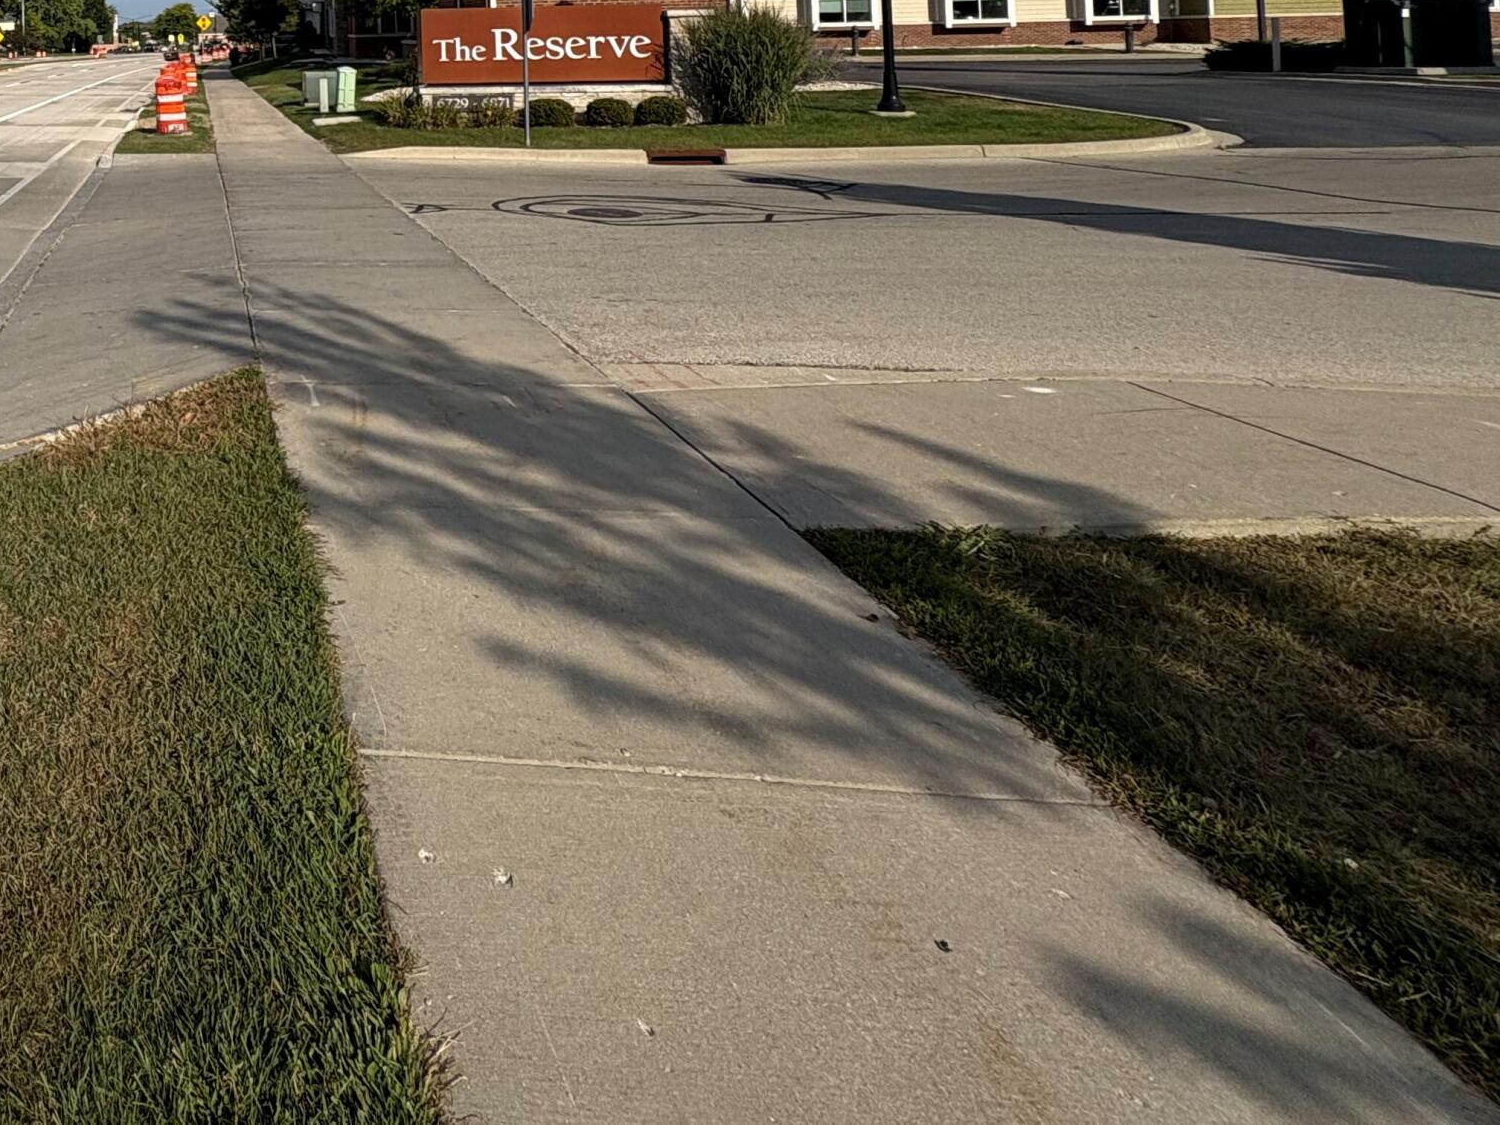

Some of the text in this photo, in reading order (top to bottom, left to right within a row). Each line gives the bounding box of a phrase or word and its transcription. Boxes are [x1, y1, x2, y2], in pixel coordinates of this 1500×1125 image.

[433, 28, 652, 62] The Reserve
[437, 97, 469, 108] 6729
